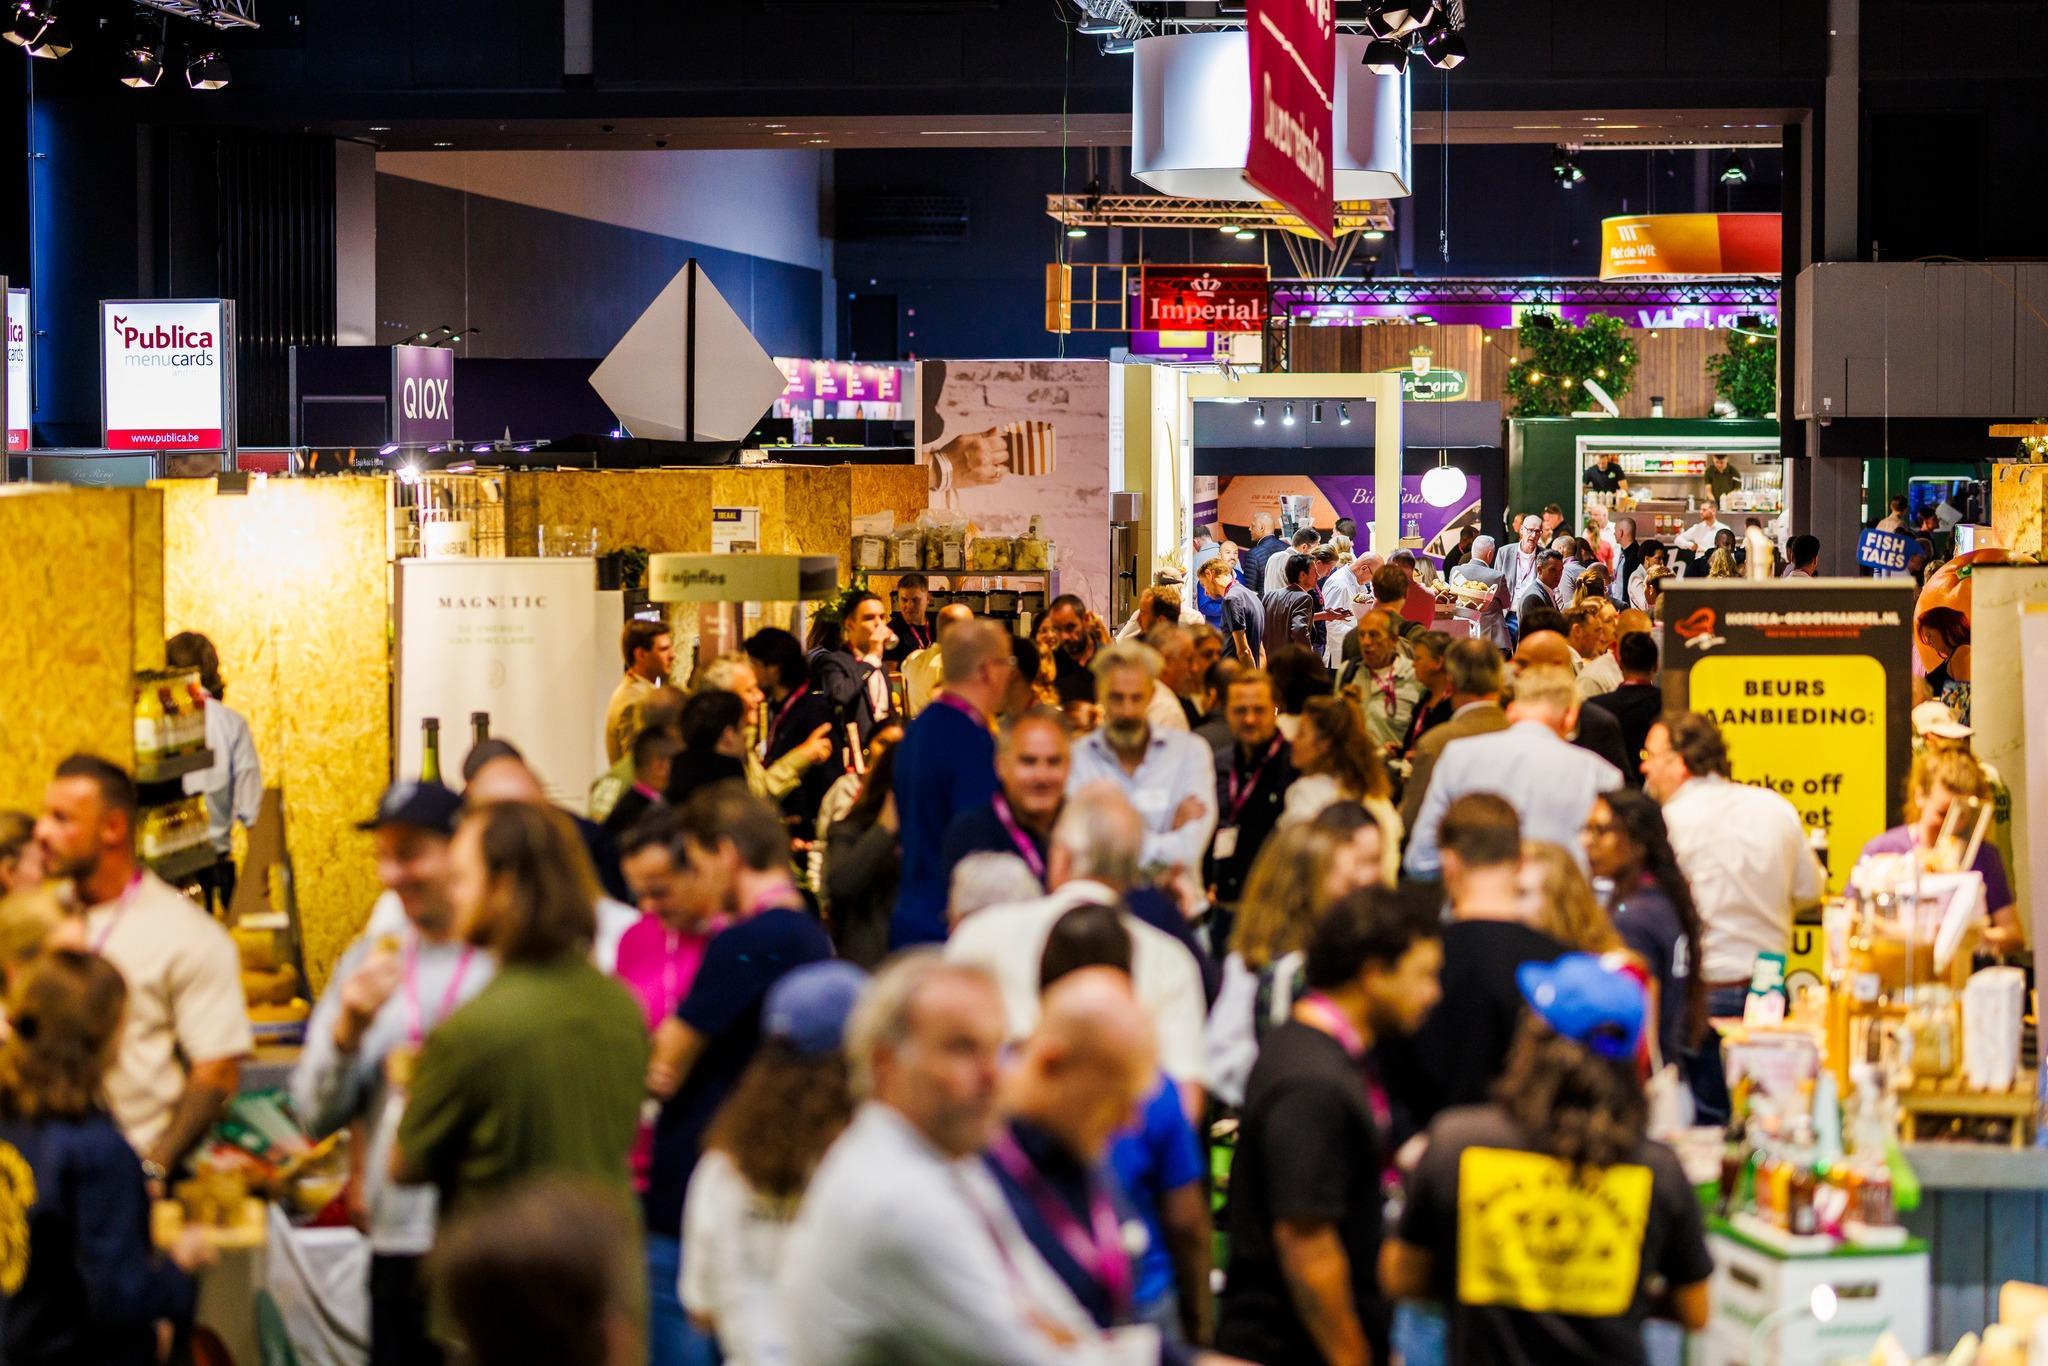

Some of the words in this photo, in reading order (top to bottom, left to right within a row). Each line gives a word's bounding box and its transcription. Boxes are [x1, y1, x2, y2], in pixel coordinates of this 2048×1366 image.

[1637, 244, 1656, 257] Wit
[1150, 298, 1259, 324] Imperial
[125, 326, 213, 349] Publica
[125, 350, 214, 366] menucards
[403, 378, 449, 420] QIOX
[131, 433, 200, 445] www.publica.be
[1865, 533, 1905, 552] FISH
[1861, 547, 1905, 568] TALES
[1744, 680, 1825, 697] BEURS
[1802, 773, 1843, 795] off
